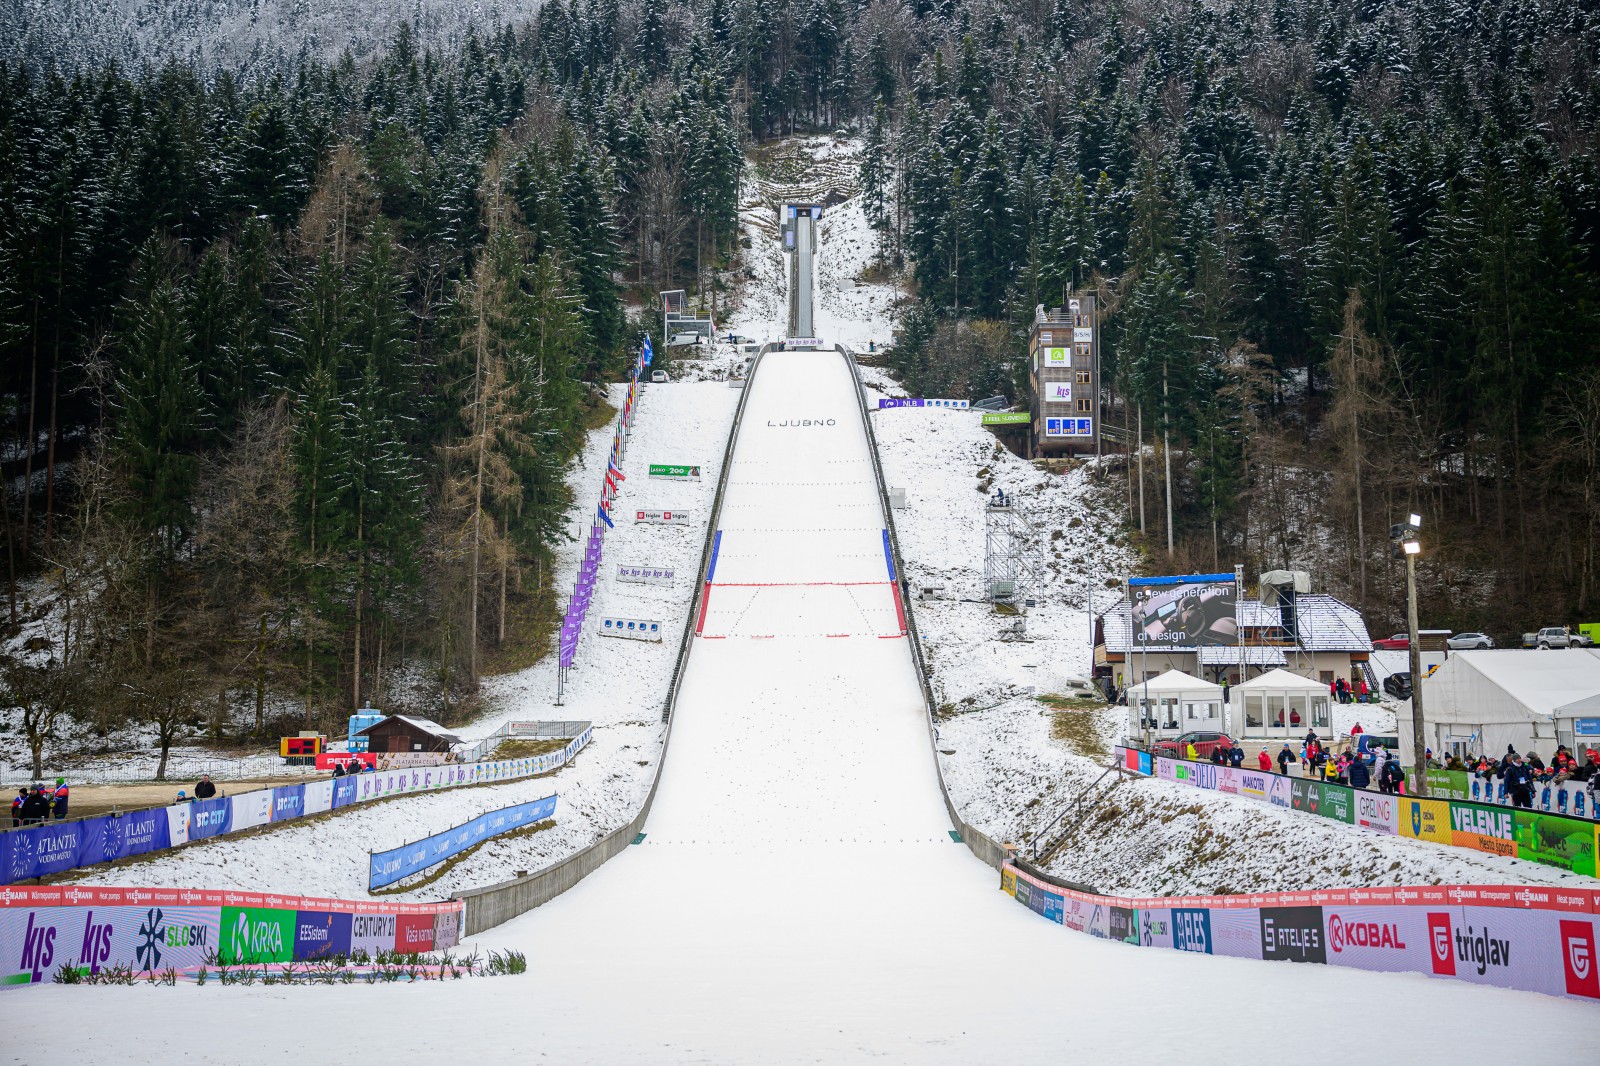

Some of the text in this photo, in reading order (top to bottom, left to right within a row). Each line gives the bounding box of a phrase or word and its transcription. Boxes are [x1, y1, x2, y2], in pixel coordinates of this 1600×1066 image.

[768, 419, 836, 427] LJUBNO
[1170, 586, 1229, 600] generation
[1151, 629, 1186, 643] design
[1195, 763, 1217, 790] DELO
[1360, 797, 1390, 821] GRELING
[124, 819, 155, 838] ATLANTIS
[196, 811, 209, 828] BTC
[1452, 806, 1513, 840] VELENJE
[36, 833, 77, 855] ATLANTIS
[1479, 837, 1495, 851] Mesto
[0, 888, 28, 905] IESSMANN
[1448, 887, 1477, 903] VIESSMANN
[1514, 889, 1585, 906] VIESSMANN Heat pumps
[167, 924, 207, 948] SLOSKI
[354, 916, 395, 937] CENTURY 21
[1345, 922, 1406, 949] KOBAL
[252, 921, 283, 953] KRKA
[1456, 925, 1510, 975] triglav
